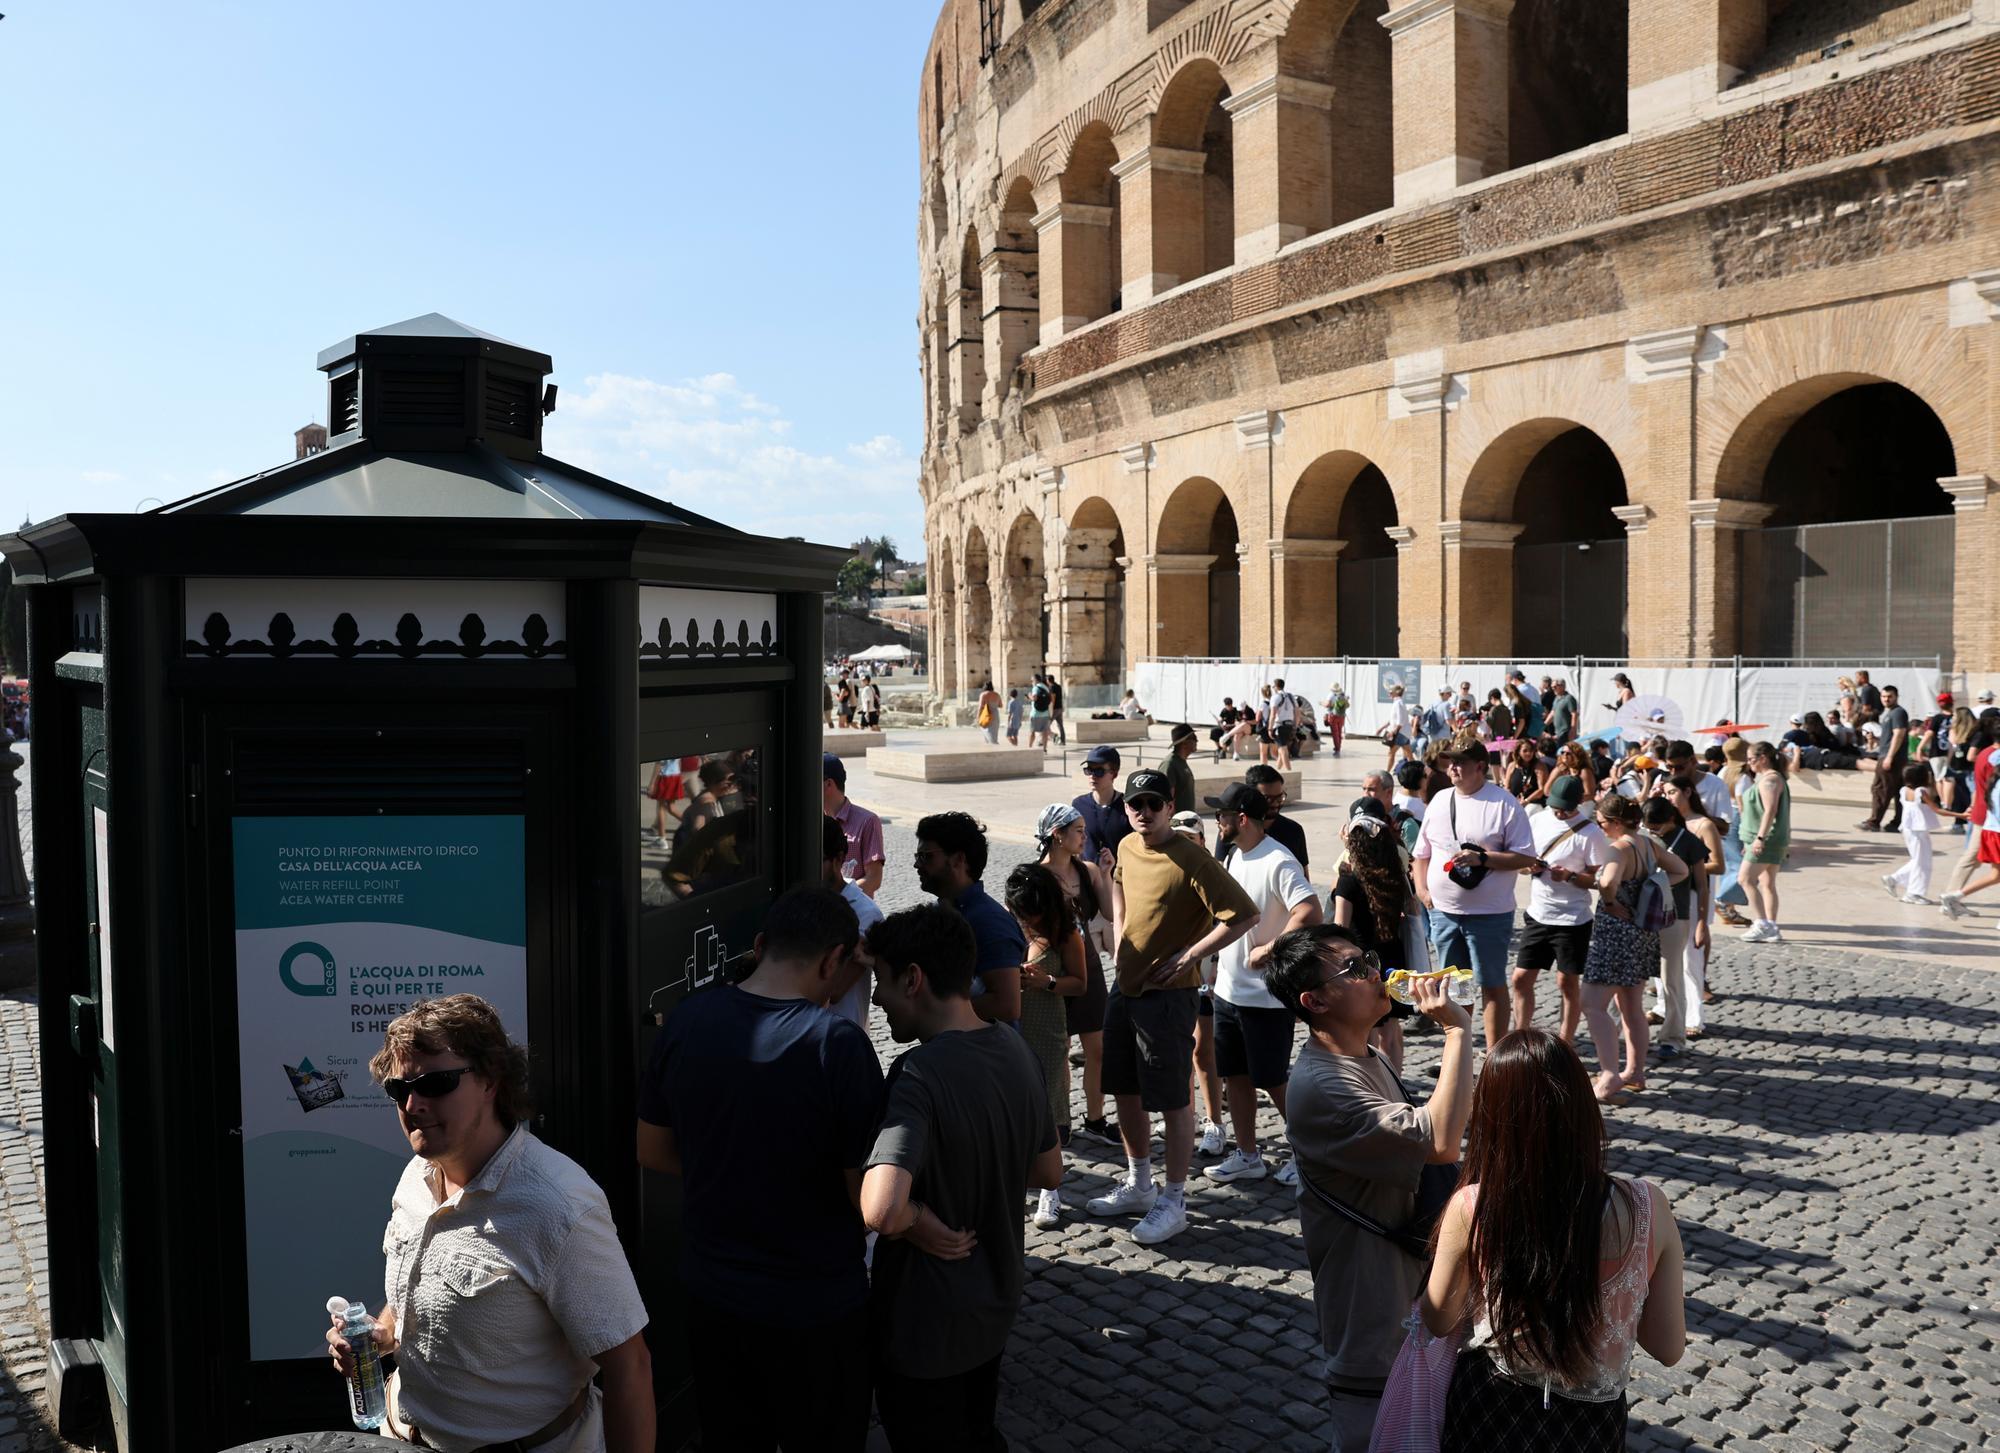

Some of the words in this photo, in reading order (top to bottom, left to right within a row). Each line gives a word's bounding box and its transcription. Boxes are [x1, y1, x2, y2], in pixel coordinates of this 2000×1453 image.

[279, 847, 321, 857] PUNTO
[324, 847, 336, 857] DI
[339, 845, 433, 857] RIFORNIMENTO
[435, 845, 479, 856] IDRICO
[279, 862, 311, 872] CASA
[314, 861, 388, 873] DELL'ACQUA
[390, 861, 422, 871] ACEA
[279, 880, 320, 890] WATER
[322, 880, 361, 890] REFILL
[364, 879, 401, 889] POINT
[280, 895, 312, 905] ACEA
[314, 895, 354, 905] WATER
[357, 894, 405, 904] CENTRE
[325, 961, 335, 995] acea
[349, 966, 415, 980] L'ACQUA
[418, 965, 434, 977] DI
[438, 965, 485, 977] ROMA
[350, 981, 358, 996] È
[362, 983, 390, 998] QUI
[395, 983, 423, 995] PER
[426, 982, 444, 994] TE
[351, 1003, 407, 1016] ROME'S
[352, 1021, 364, 1033] IS
[368, 1021, 391, 1033] HE
[327, 1055, 358, 1066] Sicura
